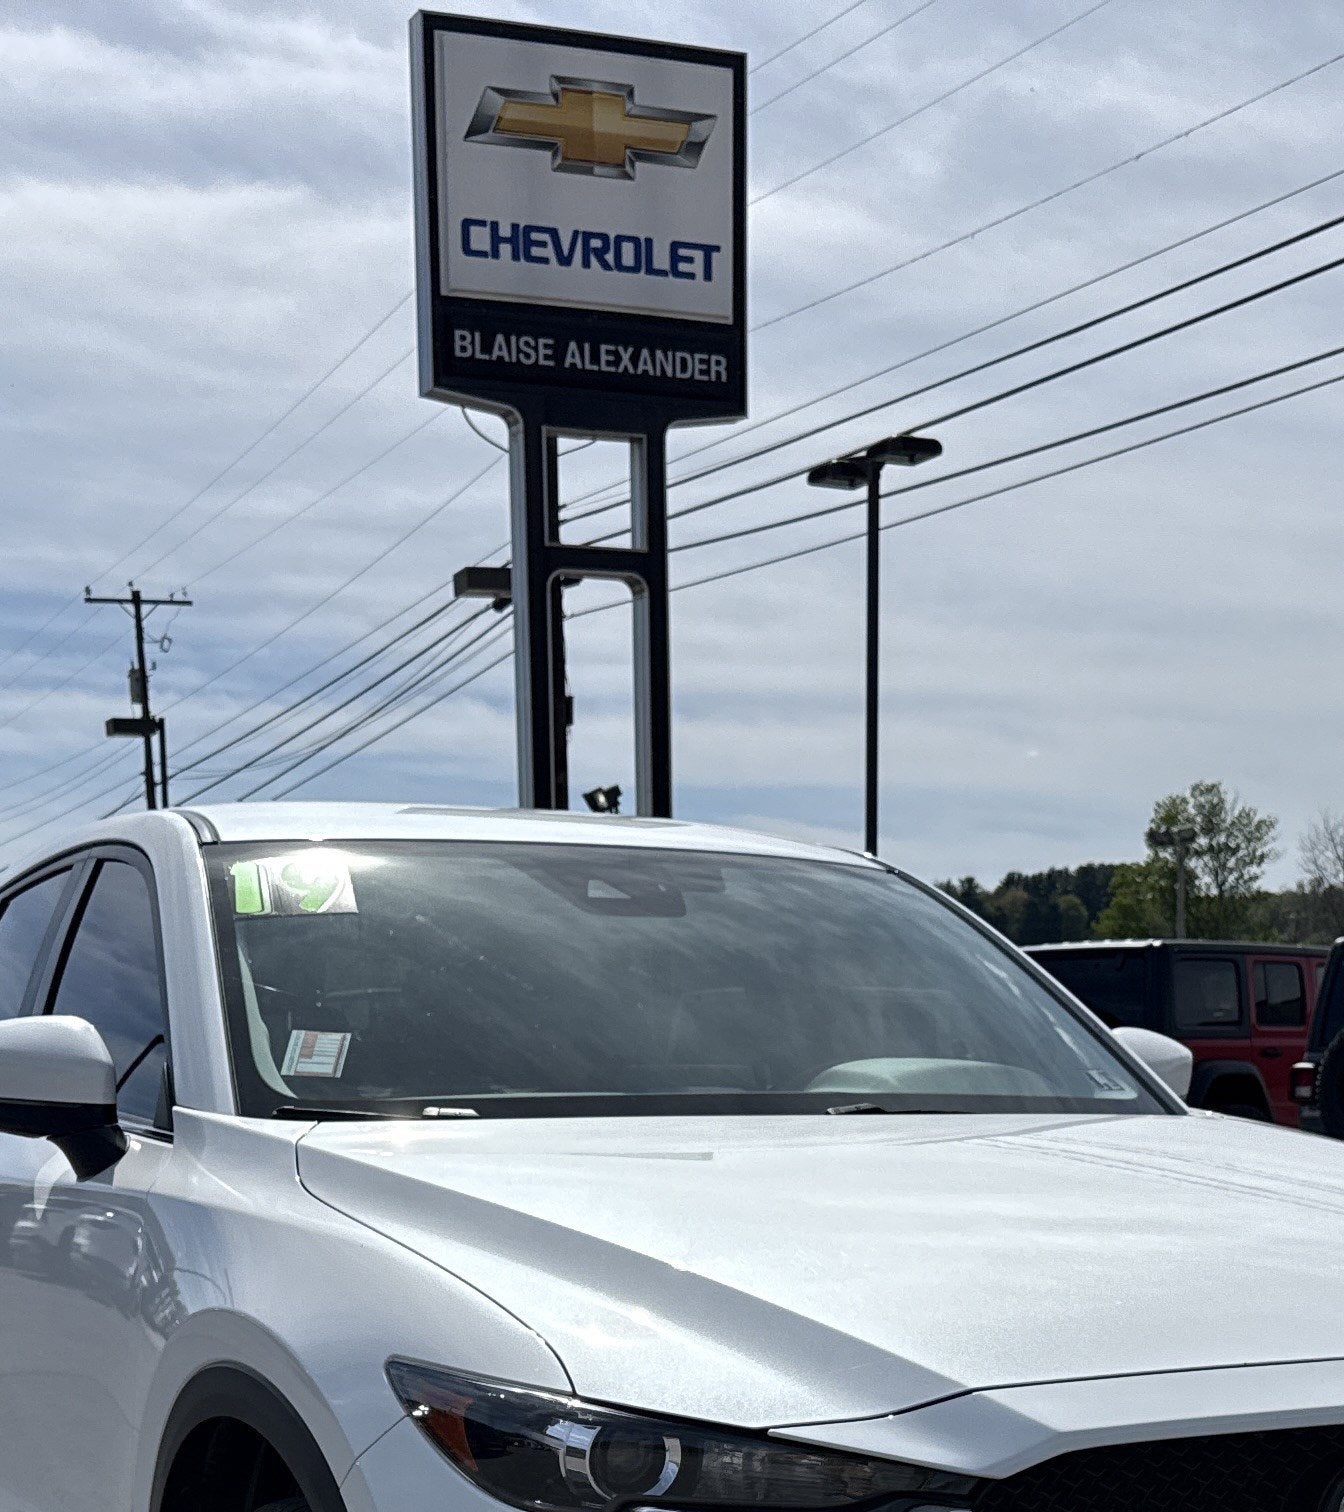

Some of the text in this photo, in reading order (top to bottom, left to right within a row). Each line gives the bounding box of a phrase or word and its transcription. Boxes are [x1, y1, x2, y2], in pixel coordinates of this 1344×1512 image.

[461, 217, 721, 282] CHEVROLET
[453, 328, 728, 383] BLAISE ALEXANDER
